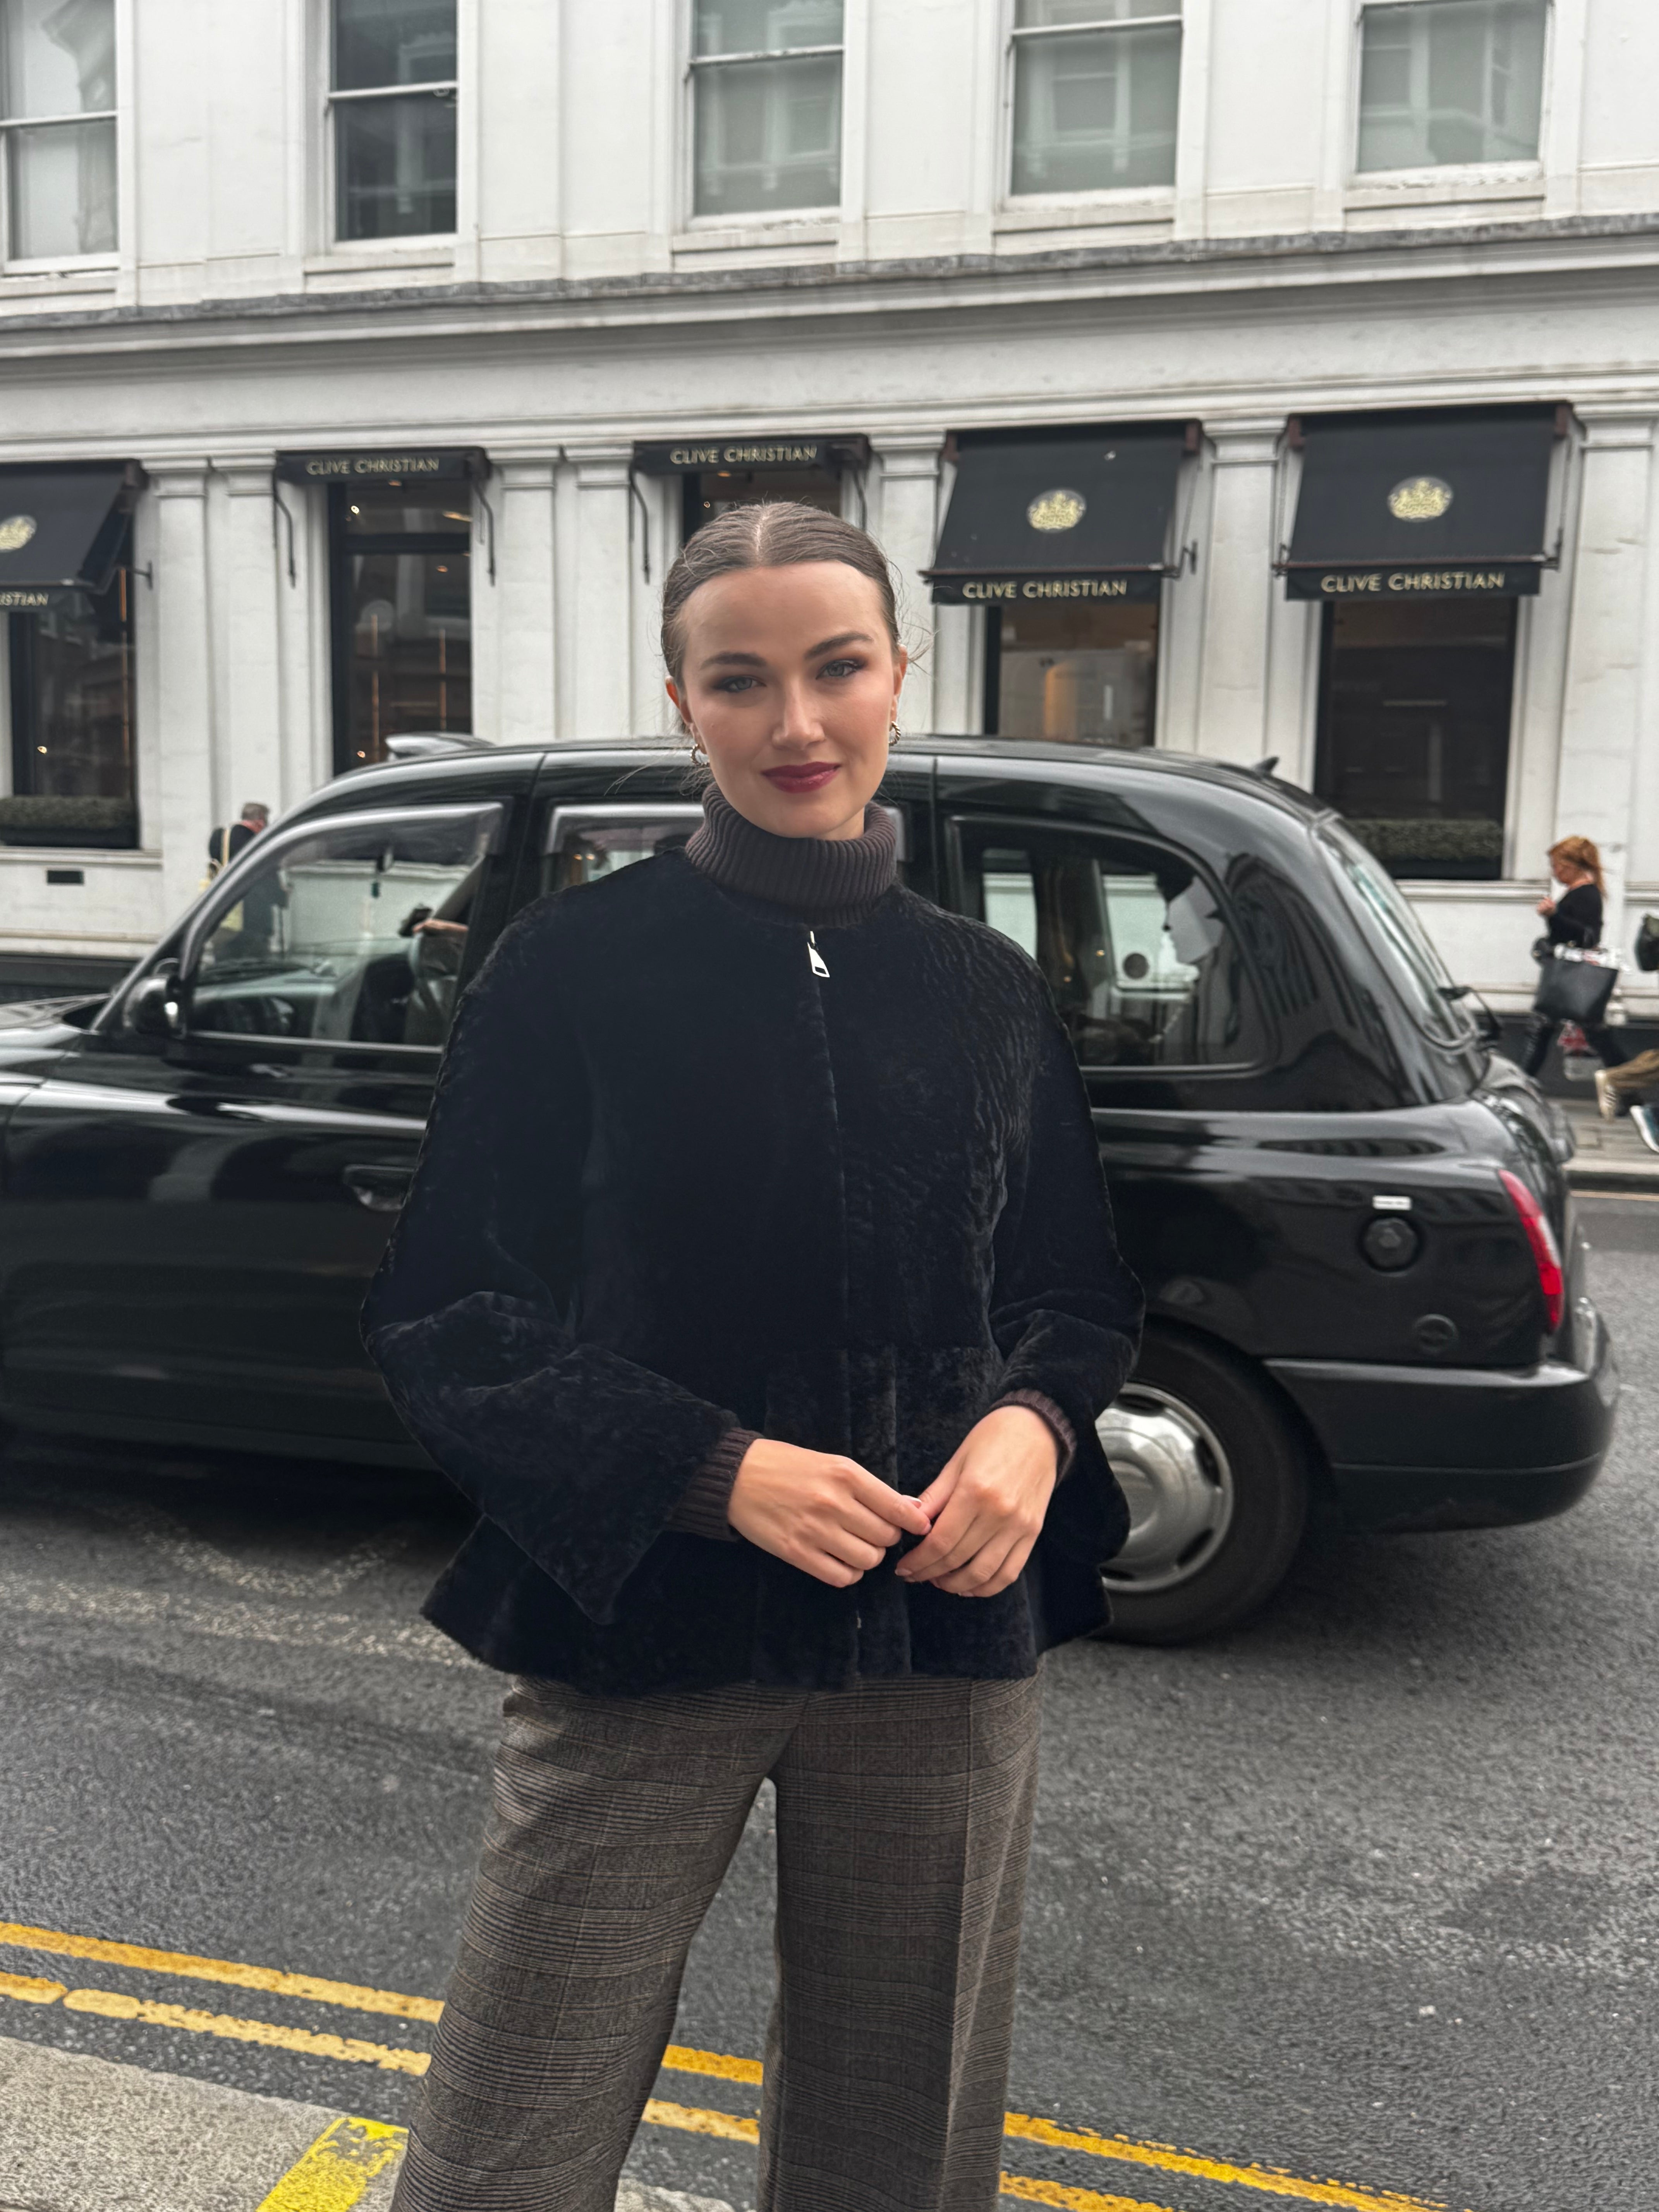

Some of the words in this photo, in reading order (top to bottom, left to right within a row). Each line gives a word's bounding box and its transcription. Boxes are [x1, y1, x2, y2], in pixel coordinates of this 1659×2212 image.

[670, 447, 719, 464] CLIVE
[724, 444, 817, 463] CHRISTIAN
[306, 458, 350, 475] CLIVE
[354, 456, 439, 473] CHRISTIAN
[962, 581, 1017, 598] CLIVE
[1022, 579, 1127, 598] CHRISTIAN
[1321, 573, 1382, 592] CLIVE
[1388, 571, 1505, 591] CHRISTIAN
